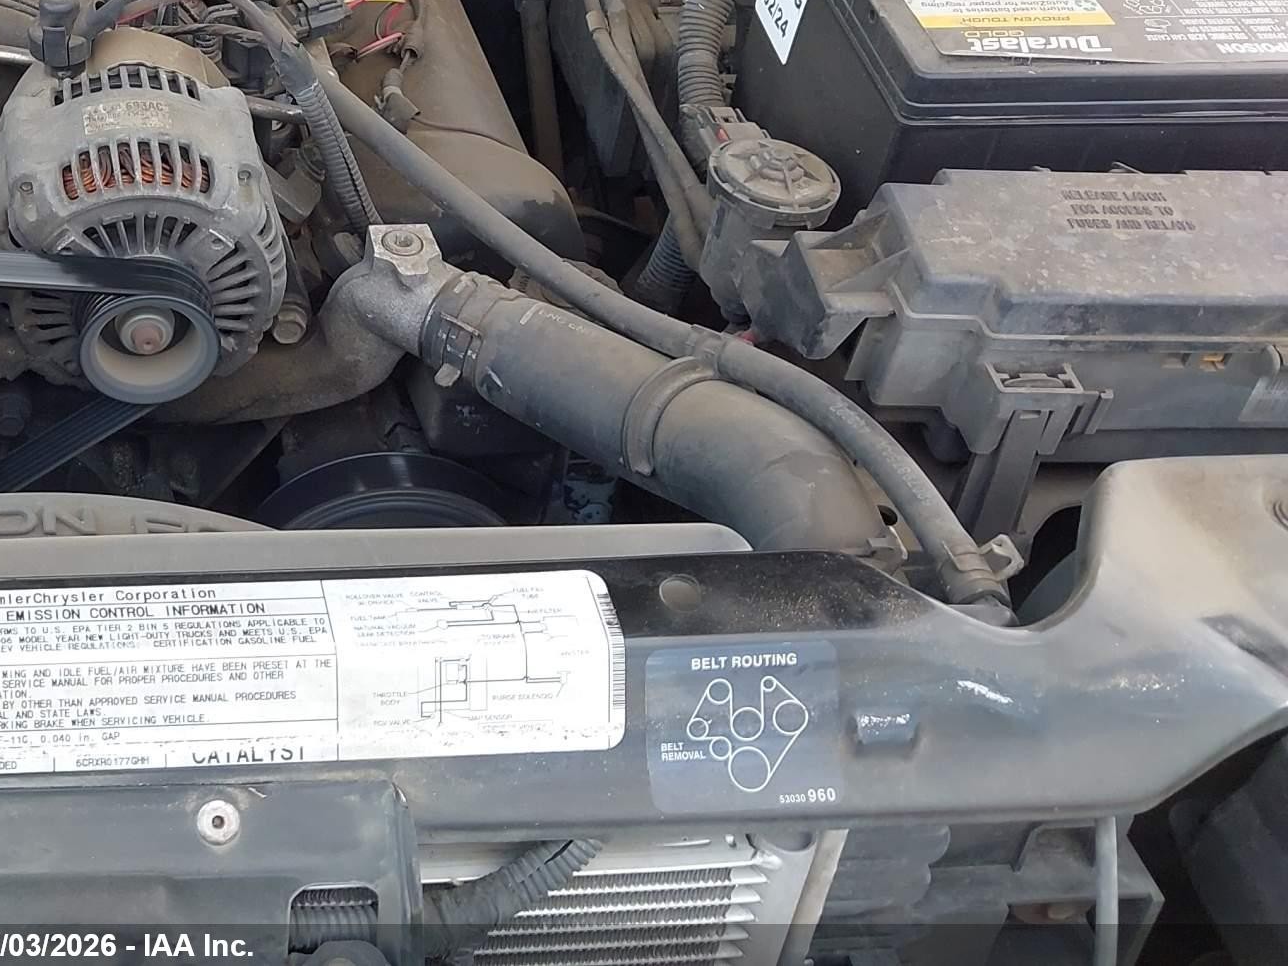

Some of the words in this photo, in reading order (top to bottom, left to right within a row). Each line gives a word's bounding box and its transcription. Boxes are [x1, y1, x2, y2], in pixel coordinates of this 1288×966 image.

[965, 34, 1113, 53] Duralast
[115, 588, 216, 603] Corporation
[6, 609, 81, 622] EMISSION
[90, 606, 153, 619] CONTROL
[166, 602, 266, 616] INFORMATION
[24, 627, 36, 635] TO
[42, 626, 66, 634] U.S.
[72, 625, 91, 633] EPA
[98, 624, 121, 632] TIER
[139, 623, 158, 631] BIN
[174, 620, 241, 630] REGULATIONS
[247, 618, 308, 627] APPLICABLE
[314, 617, 326, 625] TO
[33, 669, 51, 678] AND
[59, 667, 81, 677] IDLE
[88, 665, 137, 676] FUEL/AIR
[143, 664, 185, 674] MIXTURE
[192, 663, 216, 672] HAVE
[222, 662, 247, 671] BEEN
[253, 660, 289, 670] PRESET
[295, 660, 307, 669] AT
[315, 659, 332, 668] THE
[691, 657, 727, 670] BELT
[731, 652, 798, 668] ROUTING
[2, 679, 45, 689] SERVICE
[51, 677, 88, 687] MANUAL
[94, 676, 113, 686] FOR
[118, 675, 156, 685] PROPER
[162, 672, 223, 683] PROCEDURES
[228, 671, 248, 681] AND
[253, 670, 284, 680] OTHER
[2, 700, 15, 709] BY
[21, 698, 53, 708] OTHER
[59, 698, 83, 707] THAN
[89, 696, 138, 706] APPROVED
[144, 694, 187, 705] SERVICE
[192, 693, 229, 703] MANUAL
[235, 690, 297, 701] PROCEDURES
[15, 710, 34, 719] AND
[40, 709, 71, 718] STATE
[76, 708, 105, 717] LAWS.
[33, 719, 65, 728] BRAKE
[71, 718, 96, 727] WHEN
[101, 716, 157, 726] SERVICING
[162, 714, 210, 724] VEHICLE.
[41, 734, 71, 744] 0.040
[101, 732, 120, 741] GAP
[661, 742, 685, 752] BELT
[192, 745, 304, 764] CATALYST
[661, 750, 707, 762] REMOVAL
